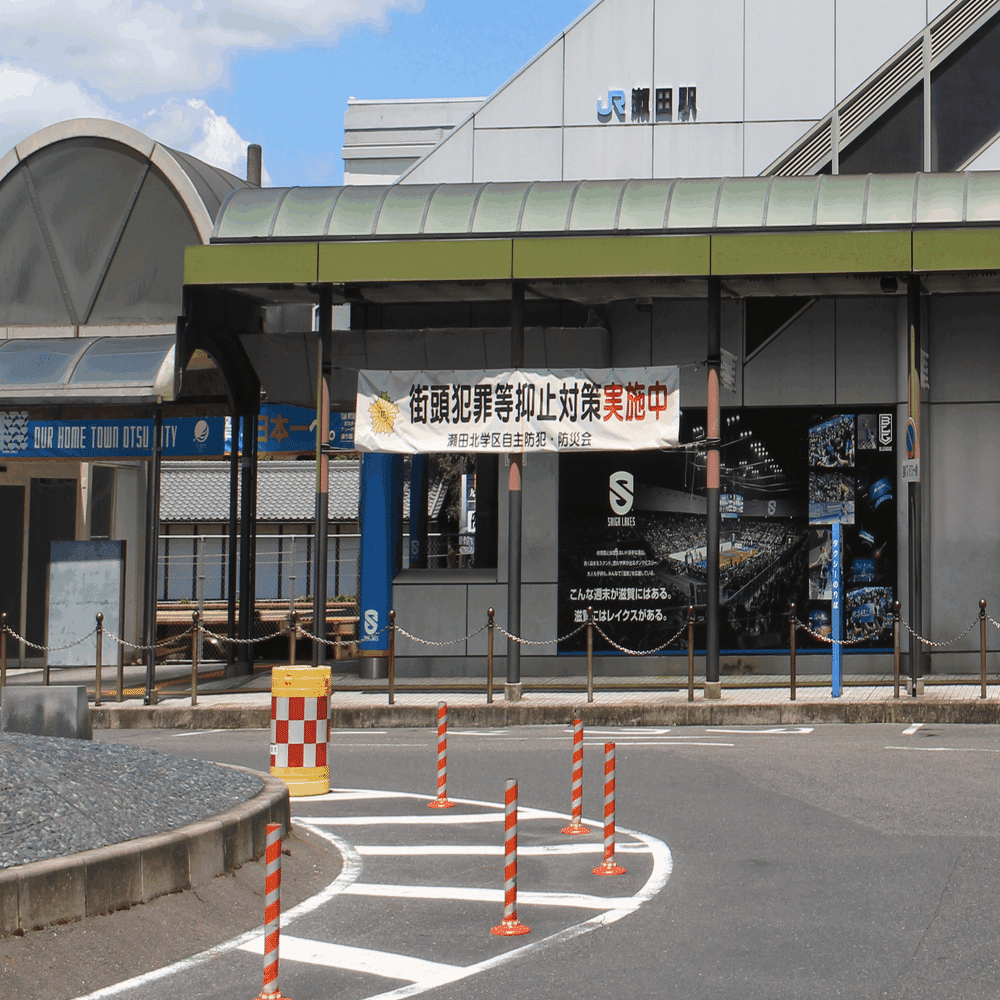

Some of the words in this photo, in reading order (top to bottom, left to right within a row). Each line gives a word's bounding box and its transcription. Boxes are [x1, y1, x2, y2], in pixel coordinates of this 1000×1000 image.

[409, 380, 668, 425] 街頭犯罪等抑止対策実施中
[33, 425, 54, 449] OUR
[57, 426, 87, 449] HOME
[91, 426, 119, 449] TOWN
[122, 425, 149, 448] OTSU
[154, 425, 178, 448] ITY
[446, 431, 592, 448] 瀬田北学区自主防犯・防災会
[607, 516, 621, 527] SHIGA
[621, 516, 636, 527] LAKES
[570, 587, 672, 601] こんな週末が滋賀にはある。
